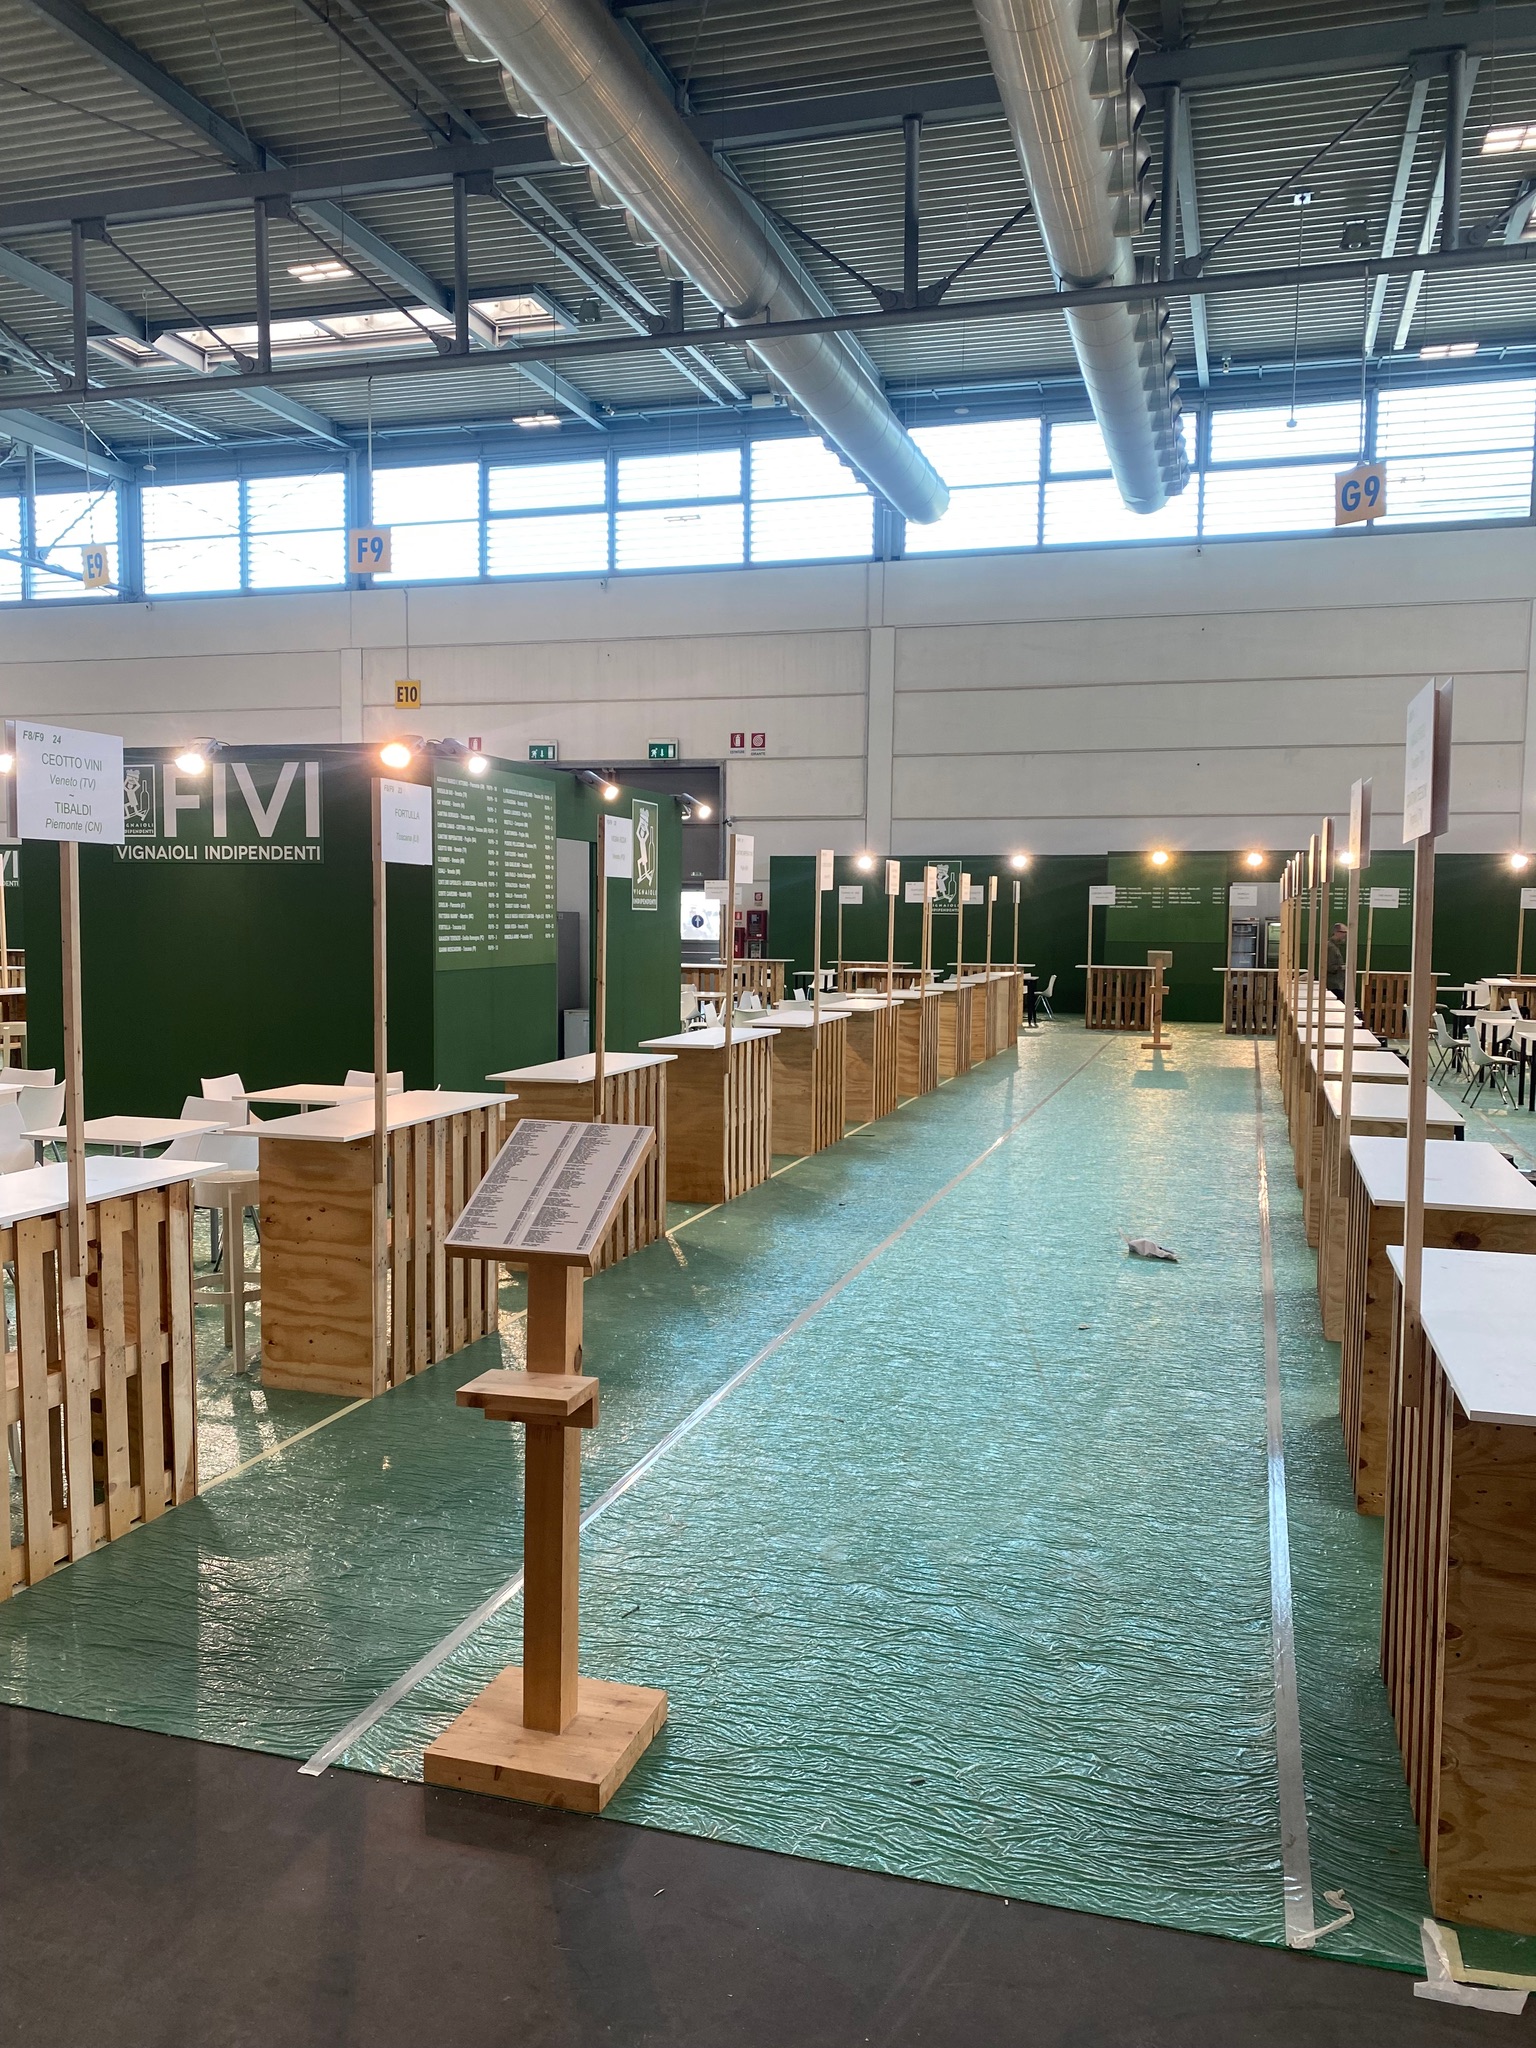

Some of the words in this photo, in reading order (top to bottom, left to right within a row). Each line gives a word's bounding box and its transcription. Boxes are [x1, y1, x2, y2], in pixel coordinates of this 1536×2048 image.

[1342, 475, 1380, 511] G9
[357, 536, 383, 563] F9
[87, 553, 103, 579] E9
[397, 686, 417, 702] E10
[23, 730, 44, 742] F8/F9
[52, 735, 61, 744] 24
[41, 753, 82, 769] CEOTTO
[84, 760, 102, 772] VINI
[49, 774, 78, 787] Veneto
[79, 778, 96, 791] (TV)
[163, 761, 321, 838] FIVI
[55, 801, 92, 816] TIBALDI
[394, 808, 420, 820] FORTULLA
[45, 818, 83, 831] Piemonte
[85, 821, 103, 834] (CN)
[116, 844, 198, 860] VIGNAIOLI
[204, 845, 321, 861] INDIPENDENTI
